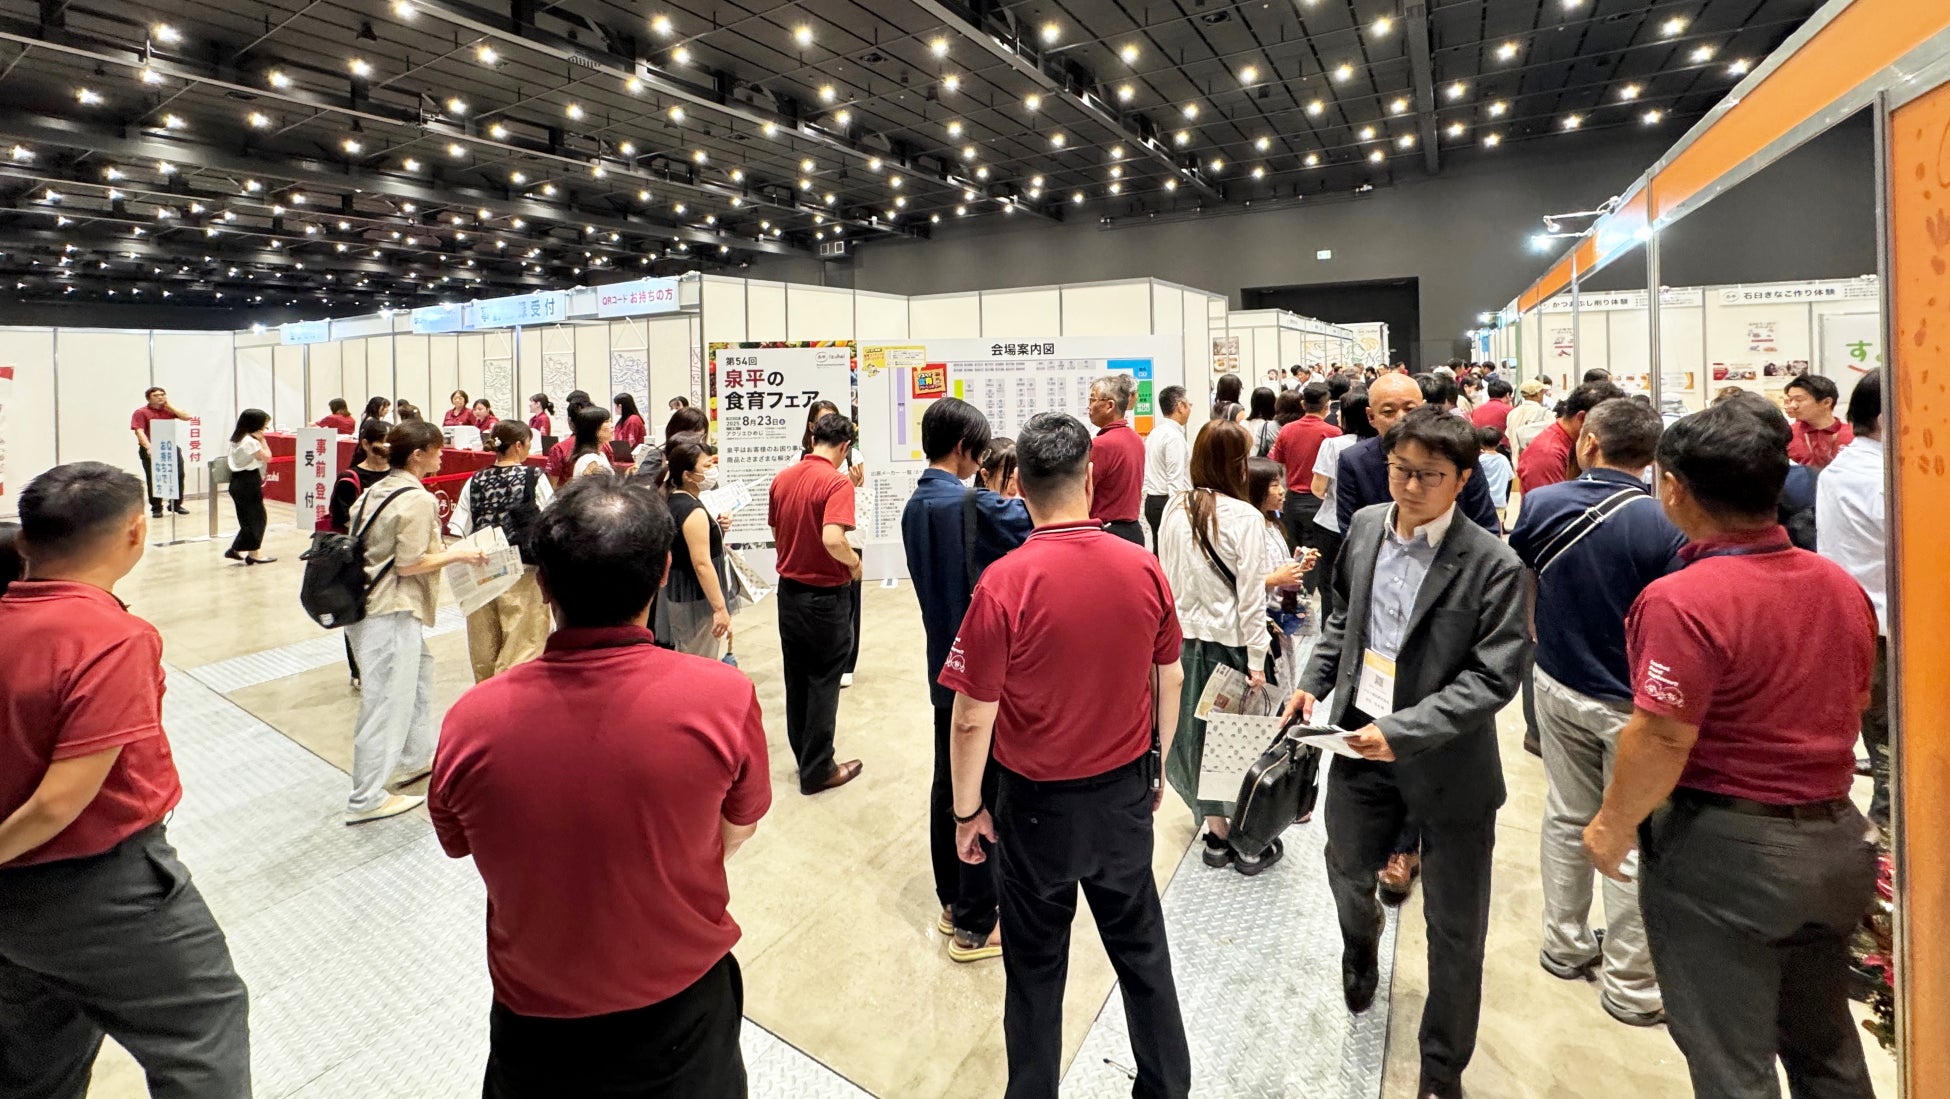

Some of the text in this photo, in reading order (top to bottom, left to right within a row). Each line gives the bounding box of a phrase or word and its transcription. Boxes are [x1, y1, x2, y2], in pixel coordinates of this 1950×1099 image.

[1743, 288, 1836, 300] 石臼きなこ作り体験
[991, 343, 1055, 356] 会場案内図
[725, 356, 758, 366] 第54回
[724, 369, 785, 389] 泉平の
[724, 390, 820, 411] 食育フェア
[189, 416, 202, 463] 当日受付
[315, 438, 327, 521] 事前登録
